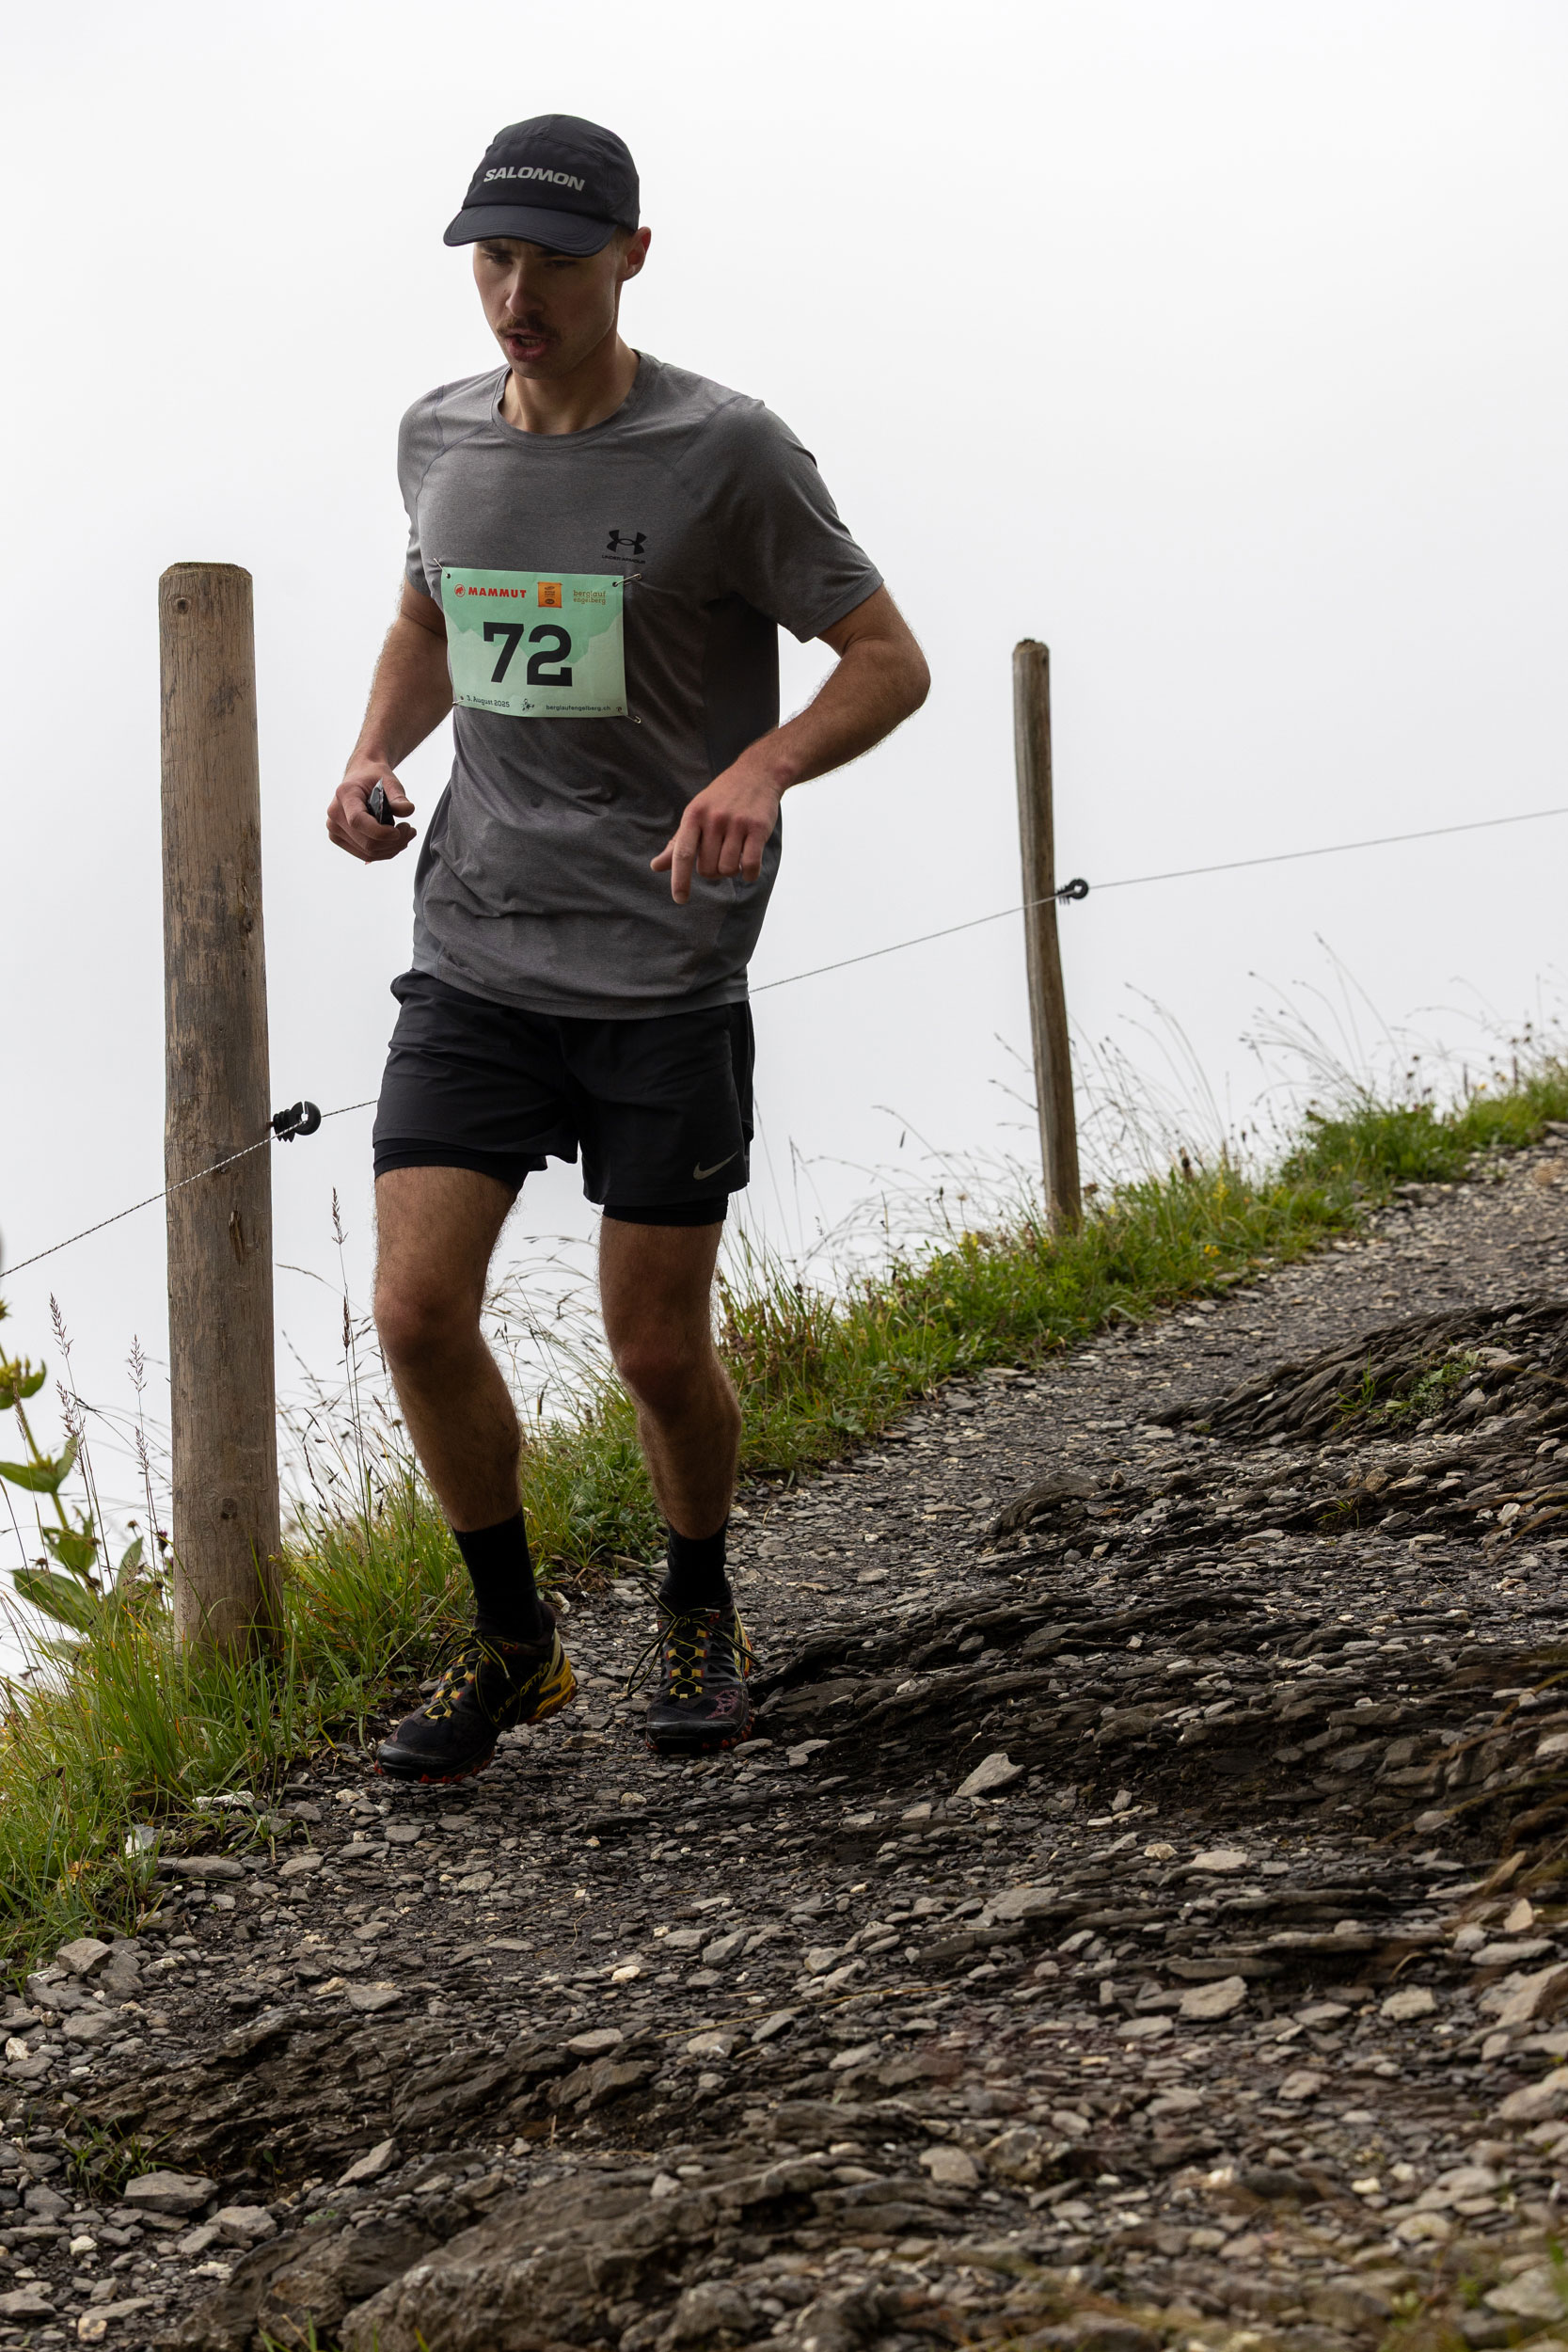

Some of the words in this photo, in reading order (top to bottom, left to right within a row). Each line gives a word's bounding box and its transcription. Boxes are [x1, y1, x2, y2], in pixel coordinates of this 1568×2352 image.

[483, 167, 585, 191] SALOMON
[467, 586, 527, 598] MAMMUT
[573, 589, 606, 598] berglauf
[483, 621, 573, 687] 72
[473, 696, 494, 706] August
[494, 699, 511, 707] 2025
